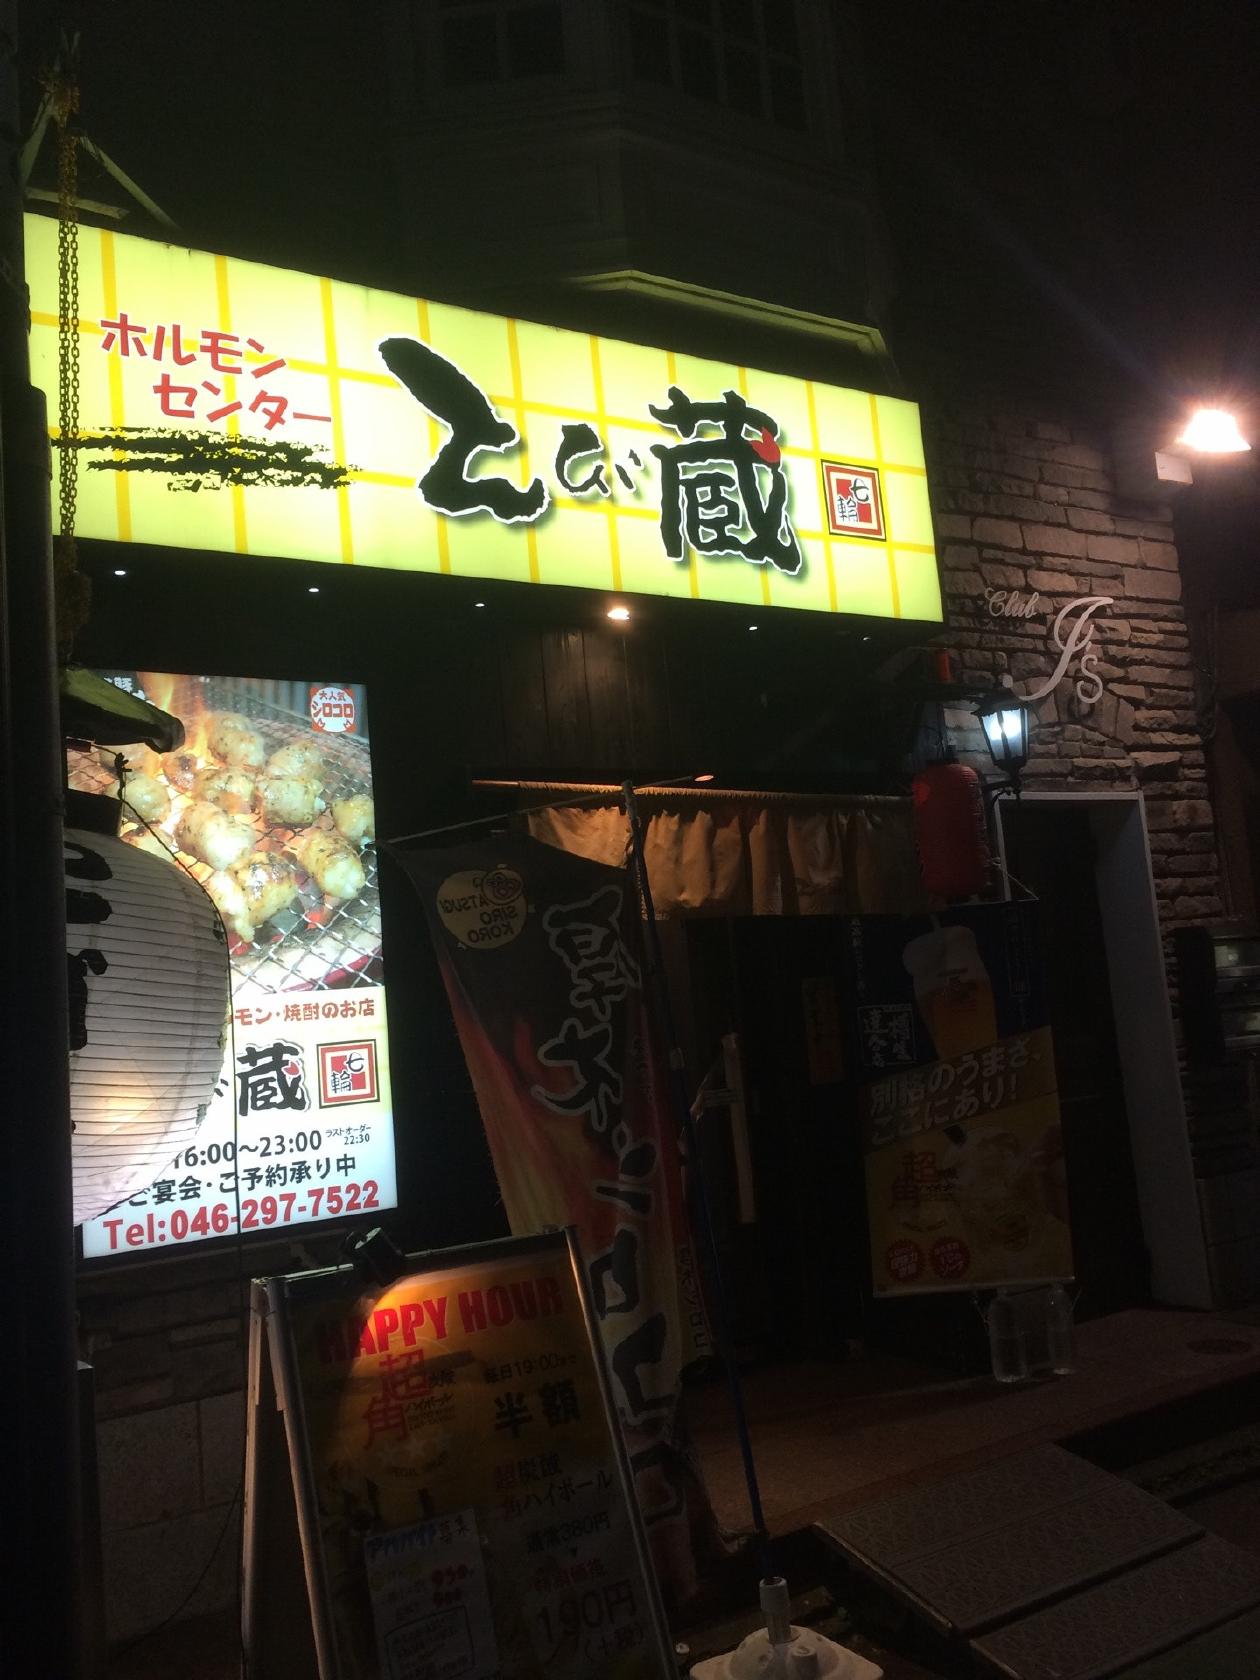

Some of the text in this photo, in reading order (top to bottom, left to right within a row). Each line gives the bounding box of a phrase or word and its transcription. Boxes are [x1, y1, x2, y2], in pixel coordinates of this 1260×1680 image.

[101, 313, 286, 378] ホルモン
[154, 373, 332, 431] センター
[985, 587, 1040, 618] Club
[311, 700, 354, 718] シロコロ
[319, 690, 347, 702] 大人気
[229, 998, 376, 1027] モン・焼酎のお店
[213, 1042, 309, 1117] 蔵
[330, 1052, 366, 1095] 七輪
[325, 1123, 372, 1138] ラストオーダー
[343, 1133, 370, 1146] 22:30
[318, 1276, 564, 1364] HAPPY HOUR
[494, 1378, 581, 1438] 半額
